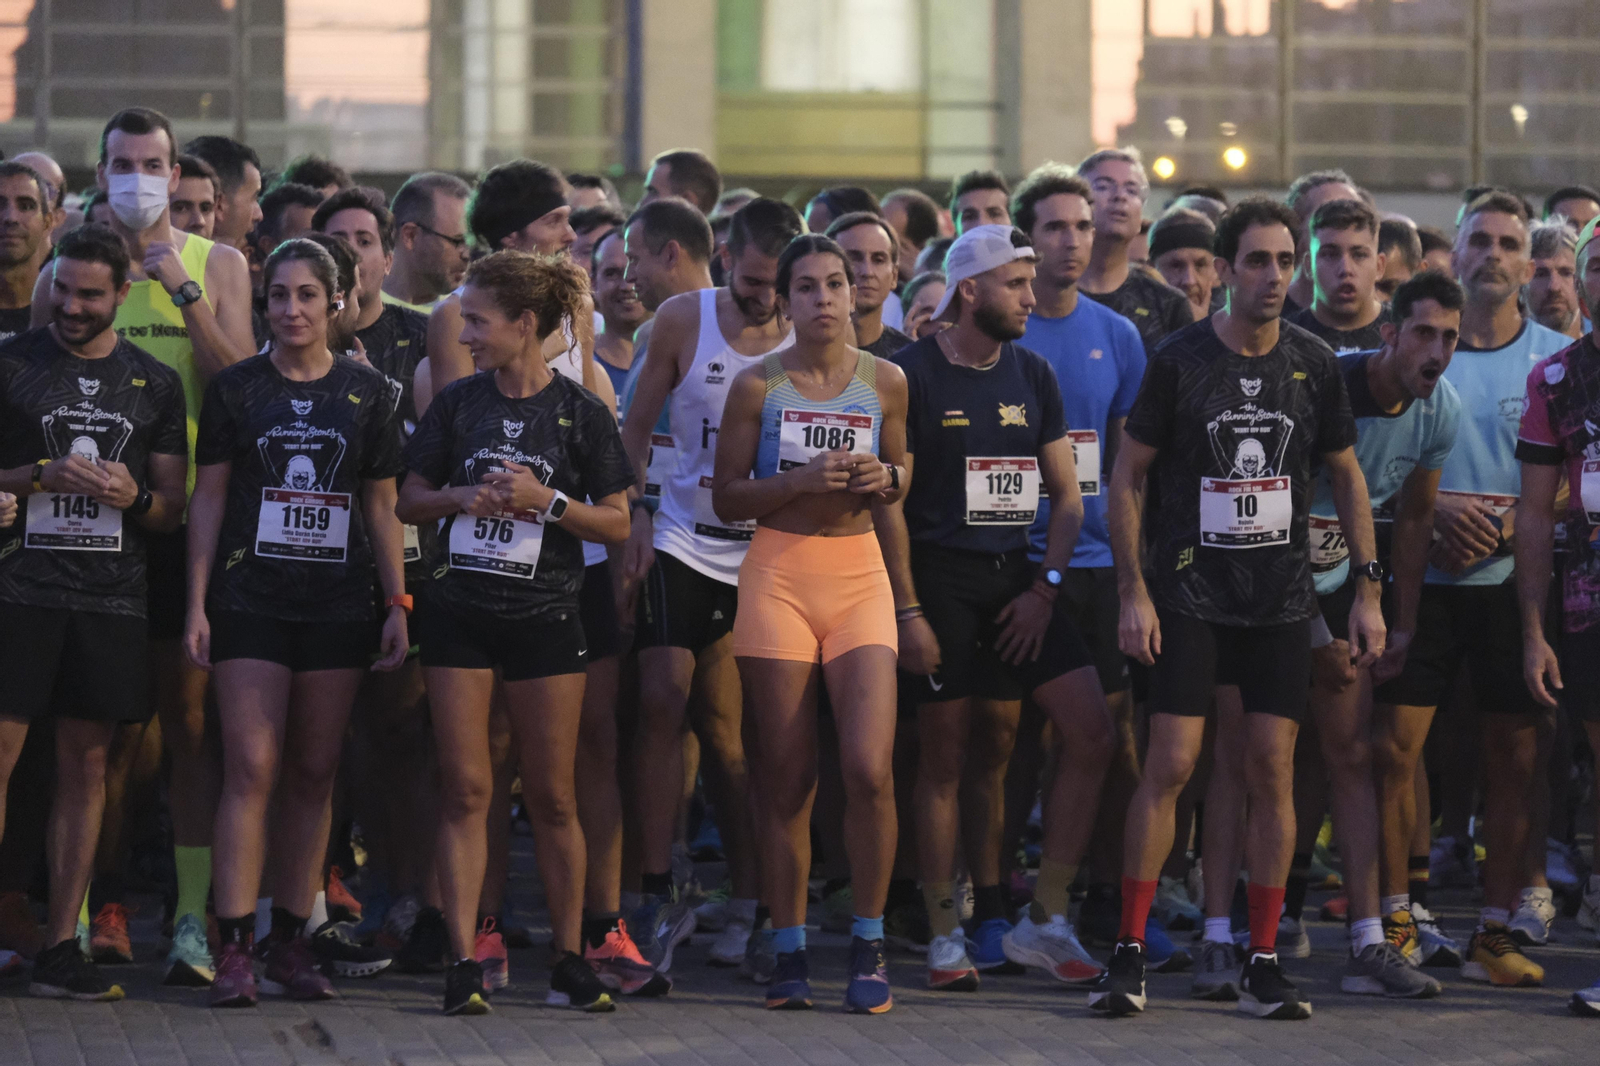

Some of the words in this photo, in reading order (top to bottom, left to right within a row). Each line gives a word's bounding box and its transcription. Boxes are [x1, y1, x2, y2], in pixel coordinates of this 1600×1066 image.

[78, 377, 100, 390] Rock
[1240, 378, 1262, 389] Rock
[76, 401, 95, 410] the
[291, 400, 313, 411] Rock
[1239, 402, 1257, 411] the
[52, 406, 91, 424] Running
[92, 408, 126, 423] Stones
[1216, 410, 1255, 426] Running
[290, 421, 309, 429] the
[503, 420, 525, 430] Rock
[266, 426, 306, 443] Running
[306, 427, 340, 439] Stones
[802, 425, 857, 452] 1086
[498, 443, 516, 452] the
[513, 451, 546, 466] Stones
[985, 472, 1023, 495] 1129
[50, 495, 99, 520] 1145
[1233, 494, 1258, 518] 10
[282, 505, 331, 531] 1159
[474, 517, 515, 544] 576
[1319, 531, 1348, 550] 27
